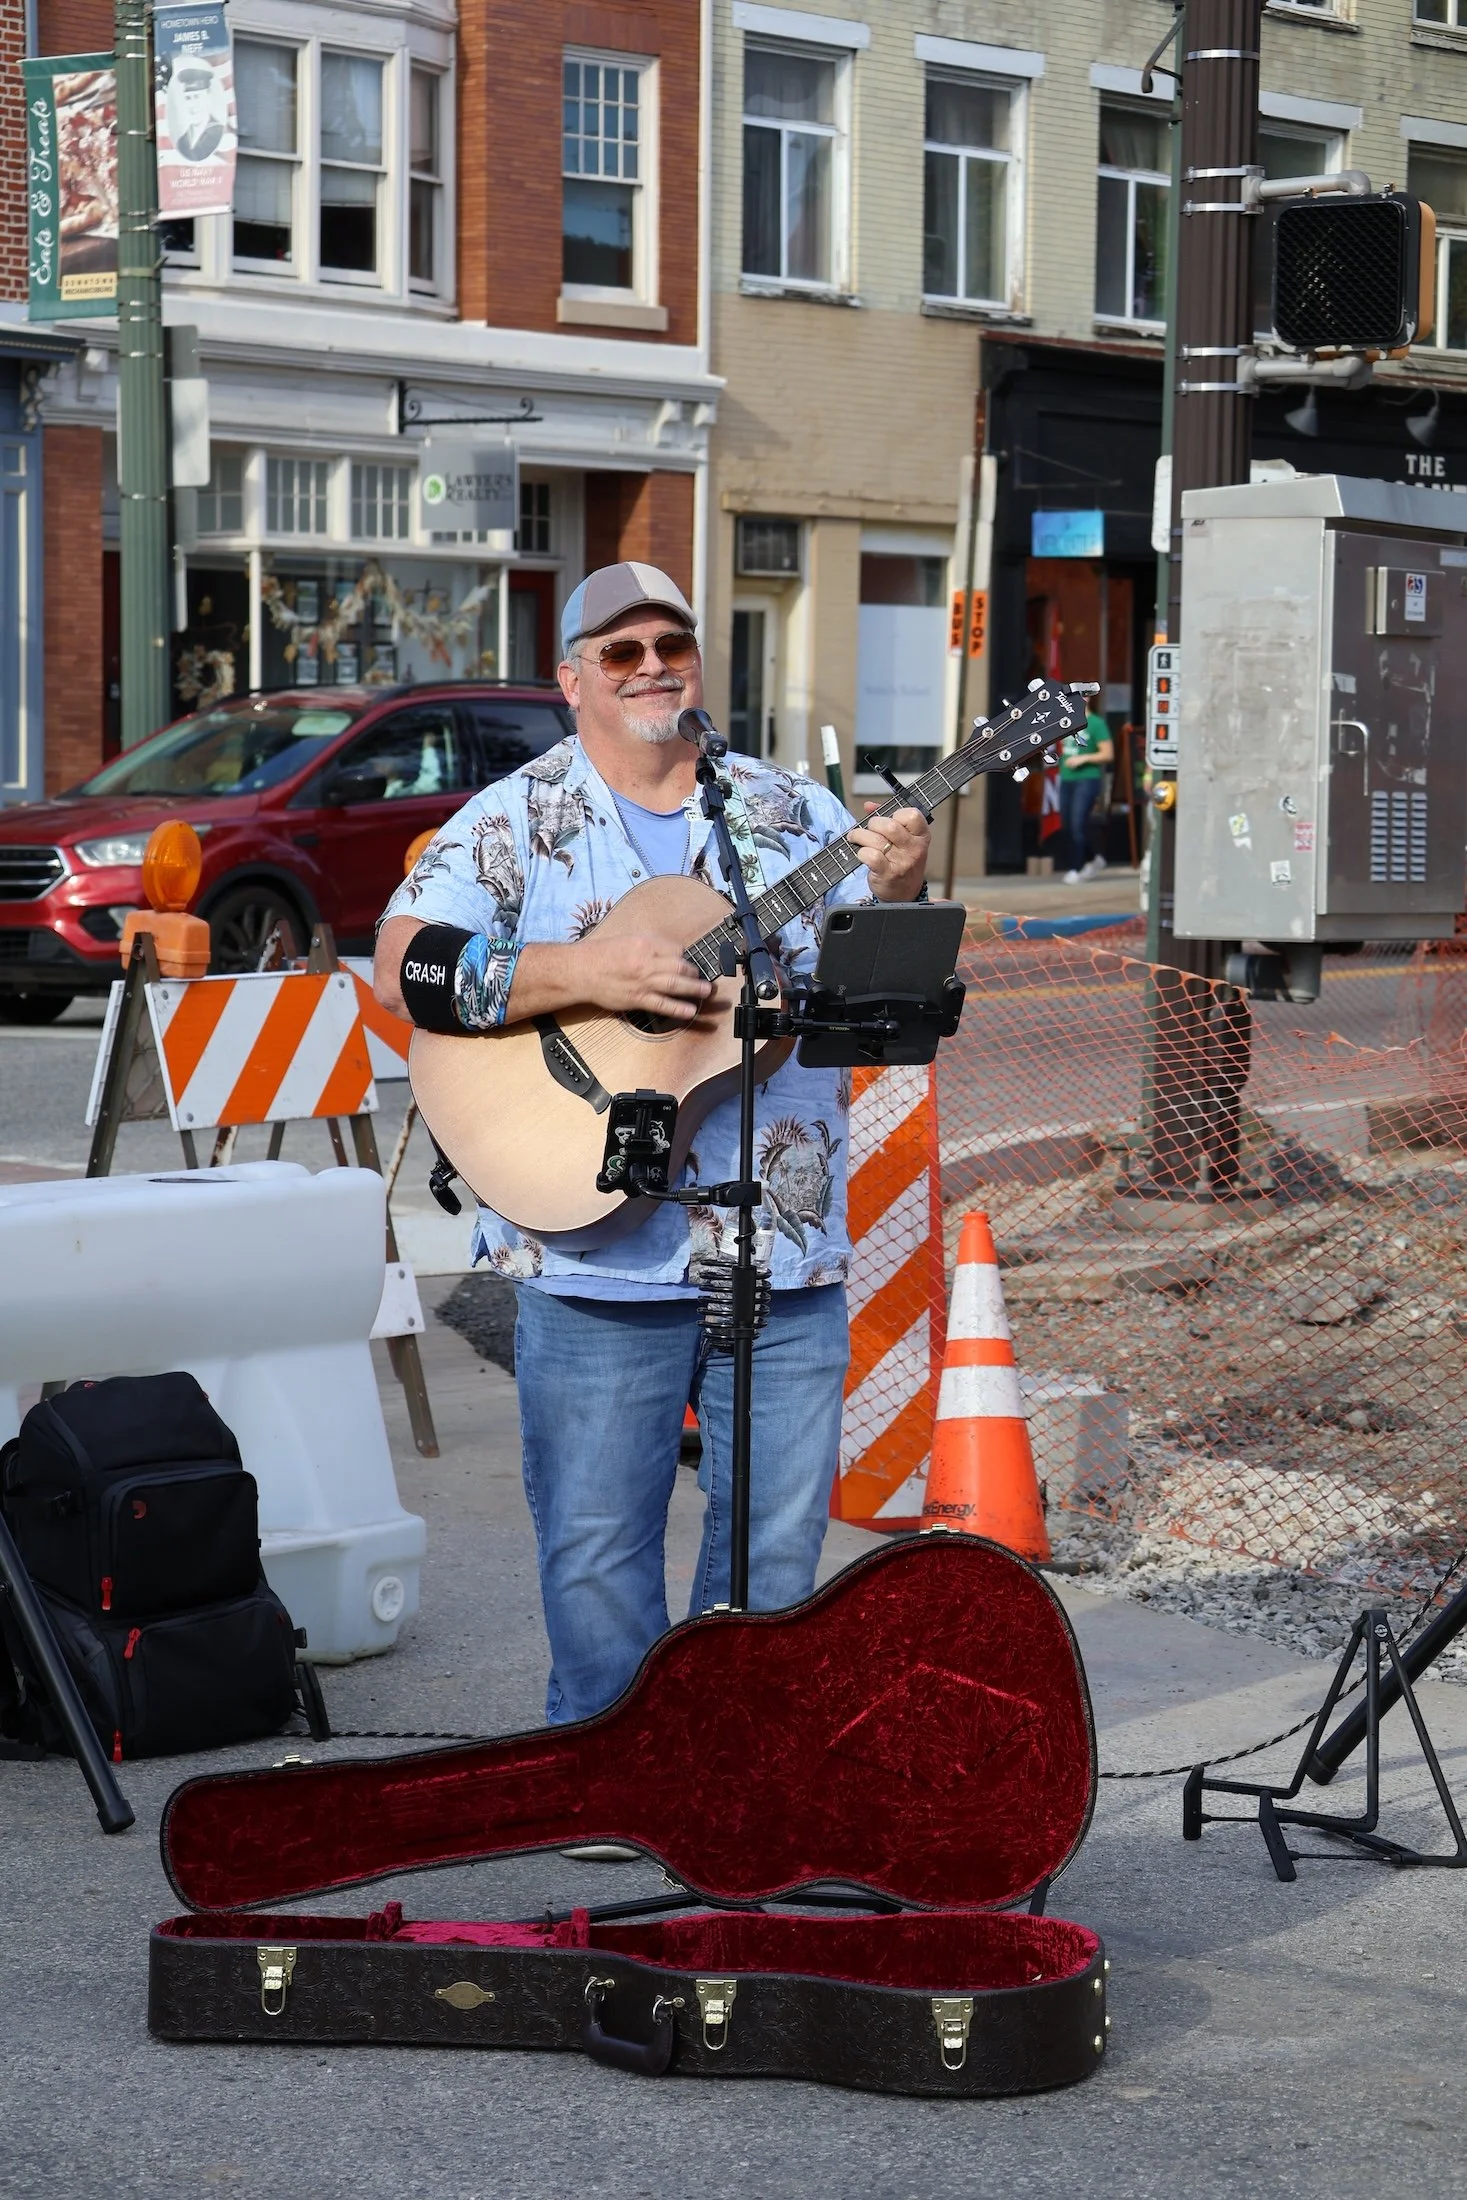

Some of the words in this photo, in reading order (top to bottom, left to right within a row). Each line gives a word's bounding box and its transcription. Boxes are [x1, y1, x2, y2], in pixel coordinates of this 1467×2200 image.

[173, 30, 200, 43] JAMES
[29, 227, 55, 285] Eat
[1405, 453, 1446, 477] THE
[951, 602, 964, 646] BUS
[971, 596, 984, 652] STOP
[1055, 690, 1076, 714] Taylor
[405, 960, 446, 986] CRASH
